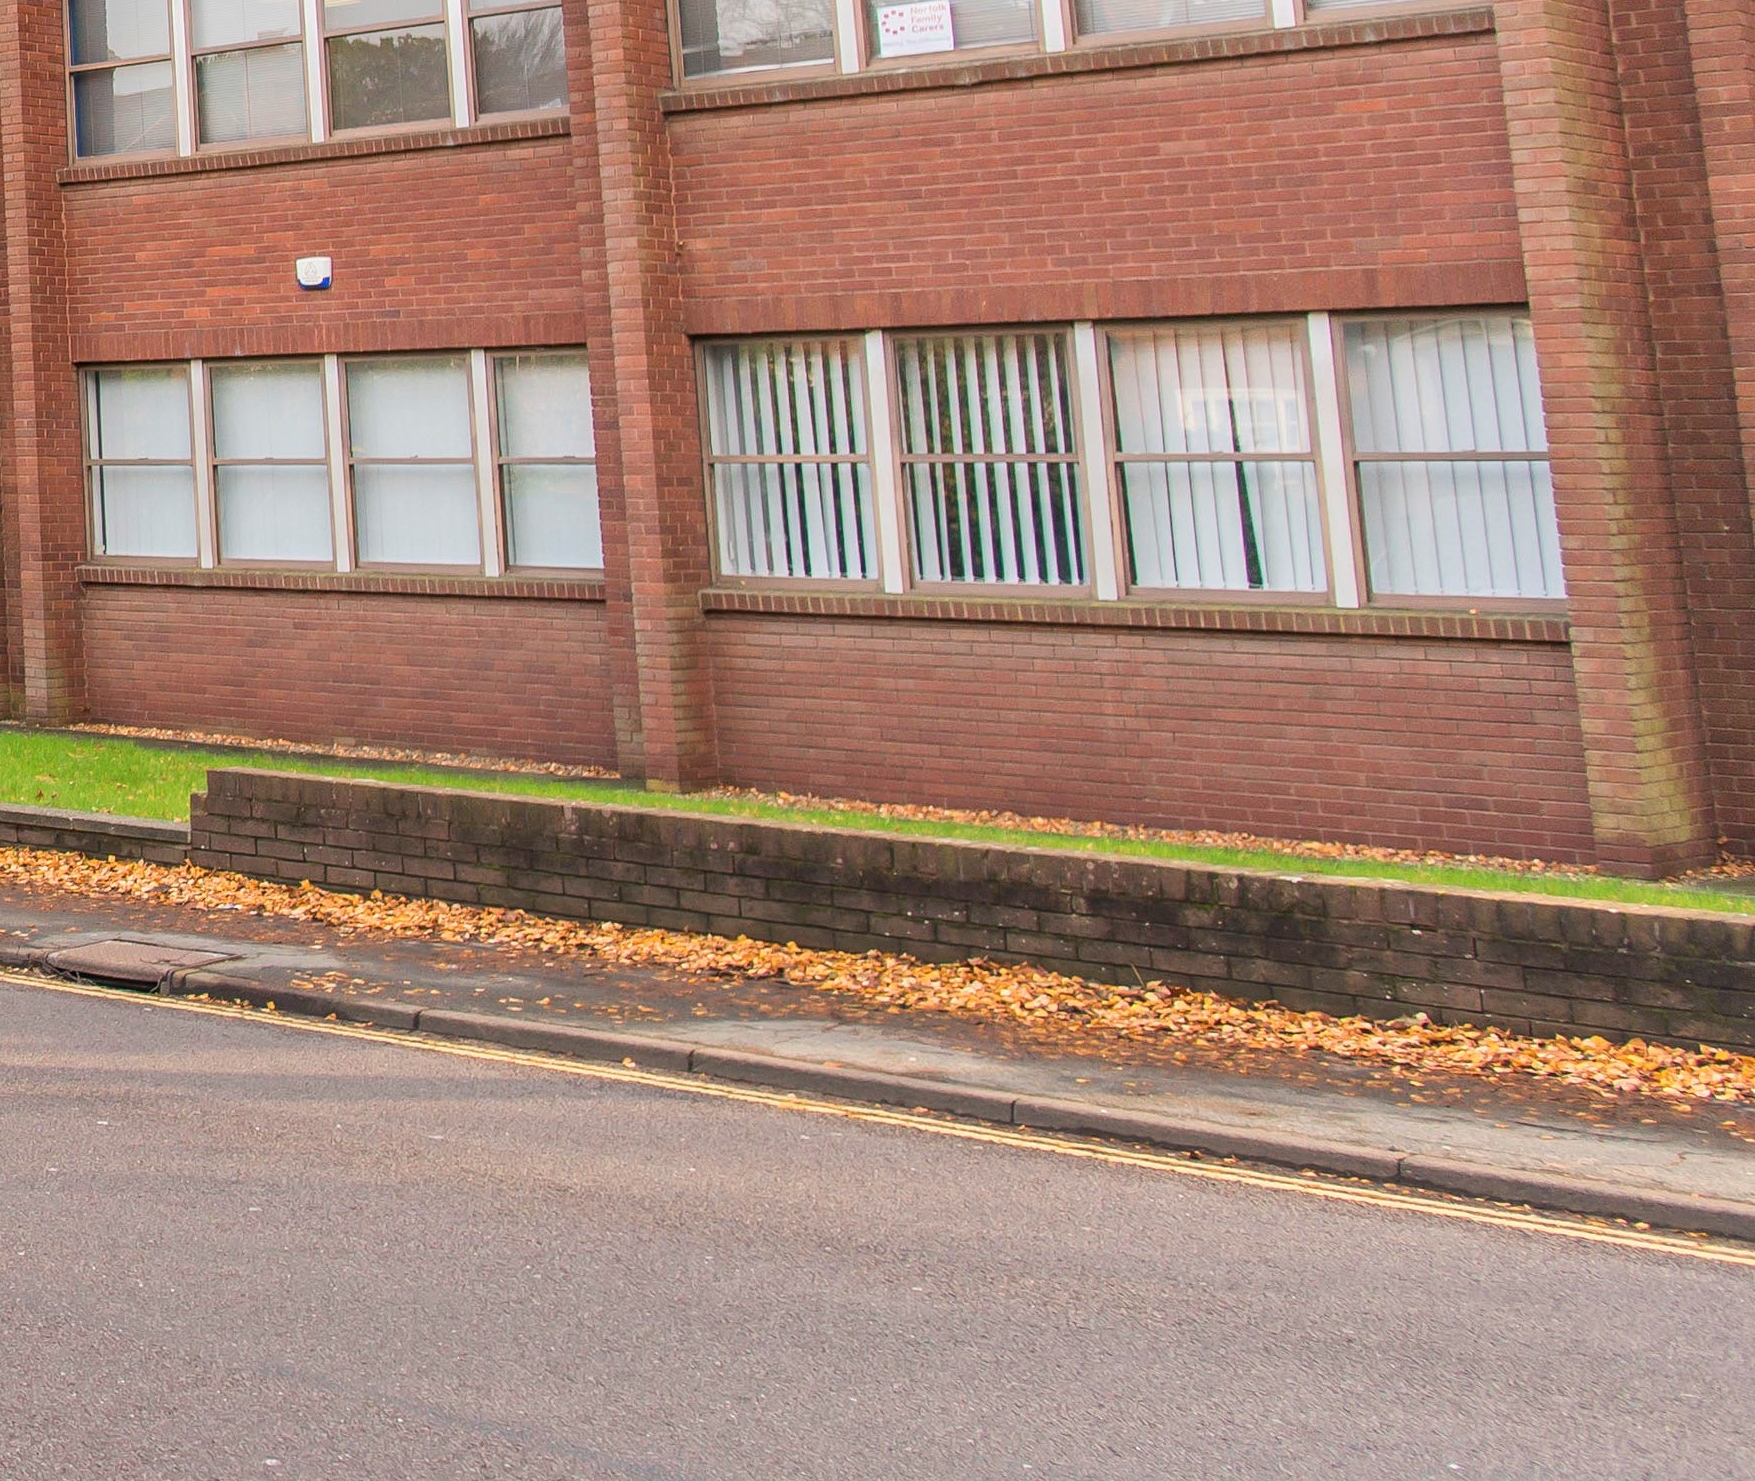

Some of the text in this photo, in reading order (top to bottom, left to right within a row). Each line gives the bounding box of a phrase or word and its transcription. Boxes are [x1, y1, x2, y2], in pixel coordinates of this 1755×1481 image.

[910, 4, 947, 15] Norfolk
[911, 14, 942, 24] Family
[912, 23, 944, 33] Carers
